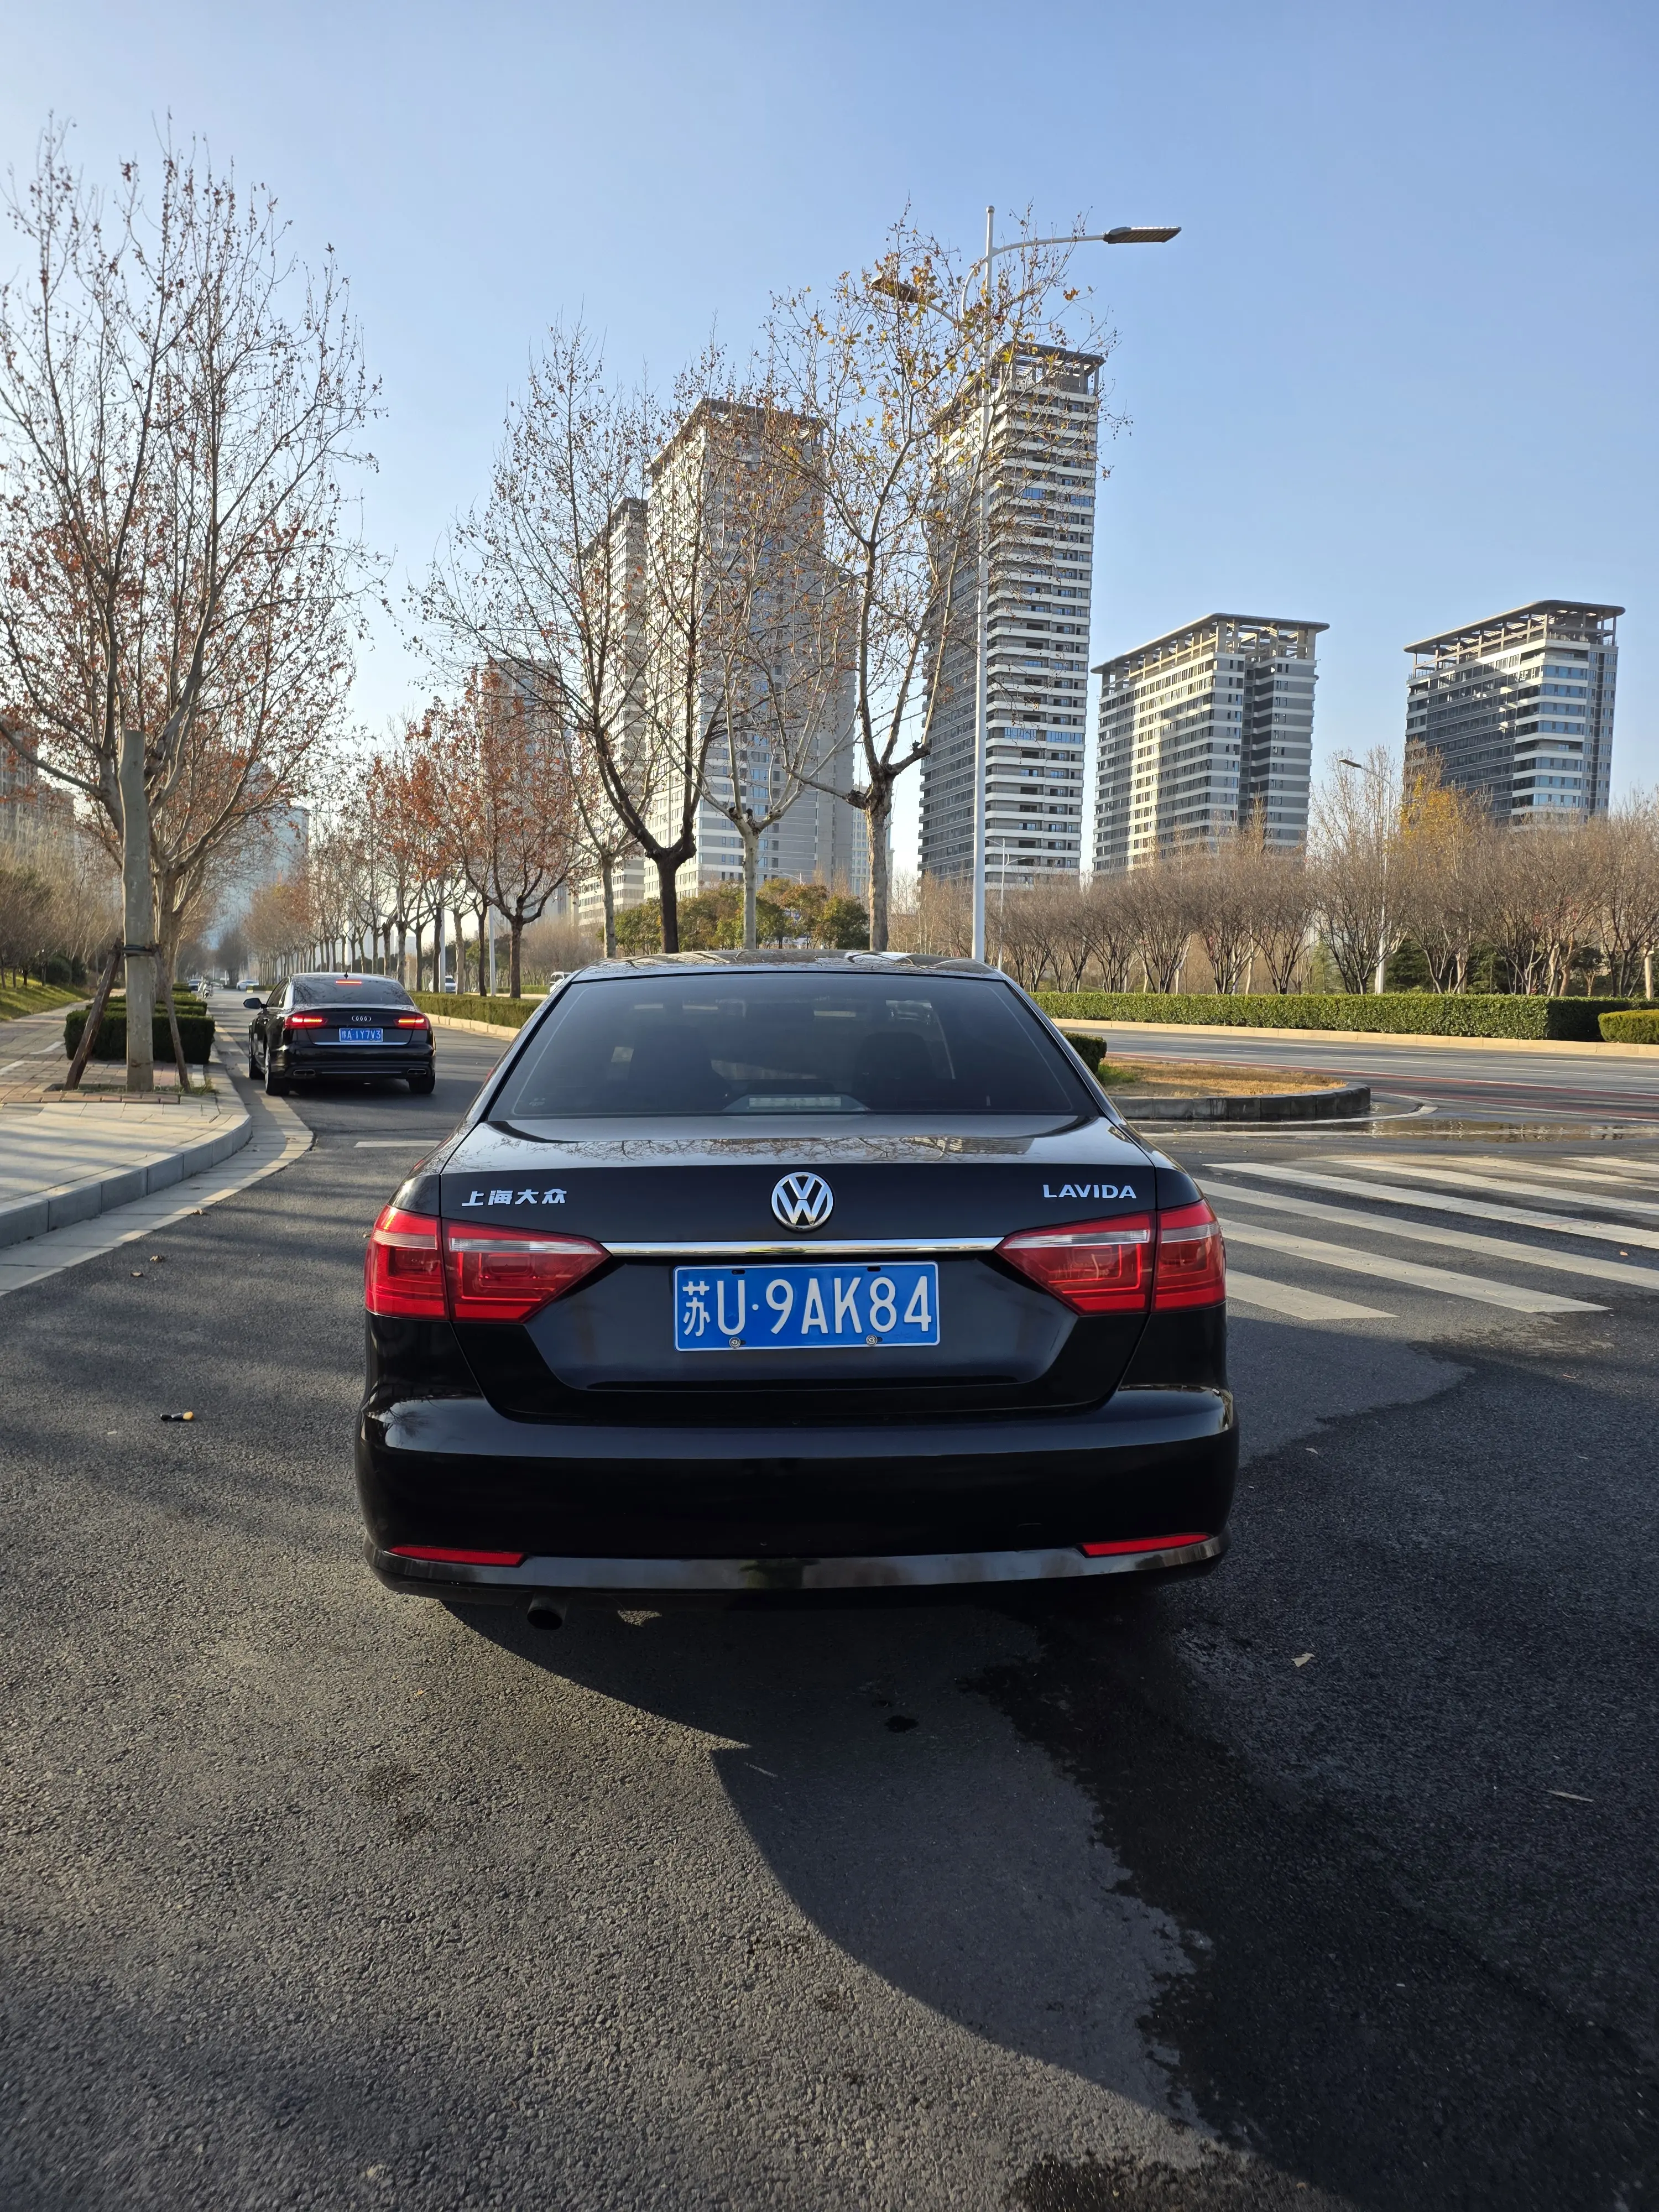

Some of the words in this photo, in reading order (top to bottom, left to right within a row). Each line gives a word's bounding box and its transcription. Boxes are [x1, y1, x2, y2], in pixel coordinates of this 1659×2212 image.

[461, 1188, 567, 1207] 上海大众
[1043, 1184, 1137, 1199] LAVIDA
[682, 1276, 932, 1337] 苏U·9AK84
